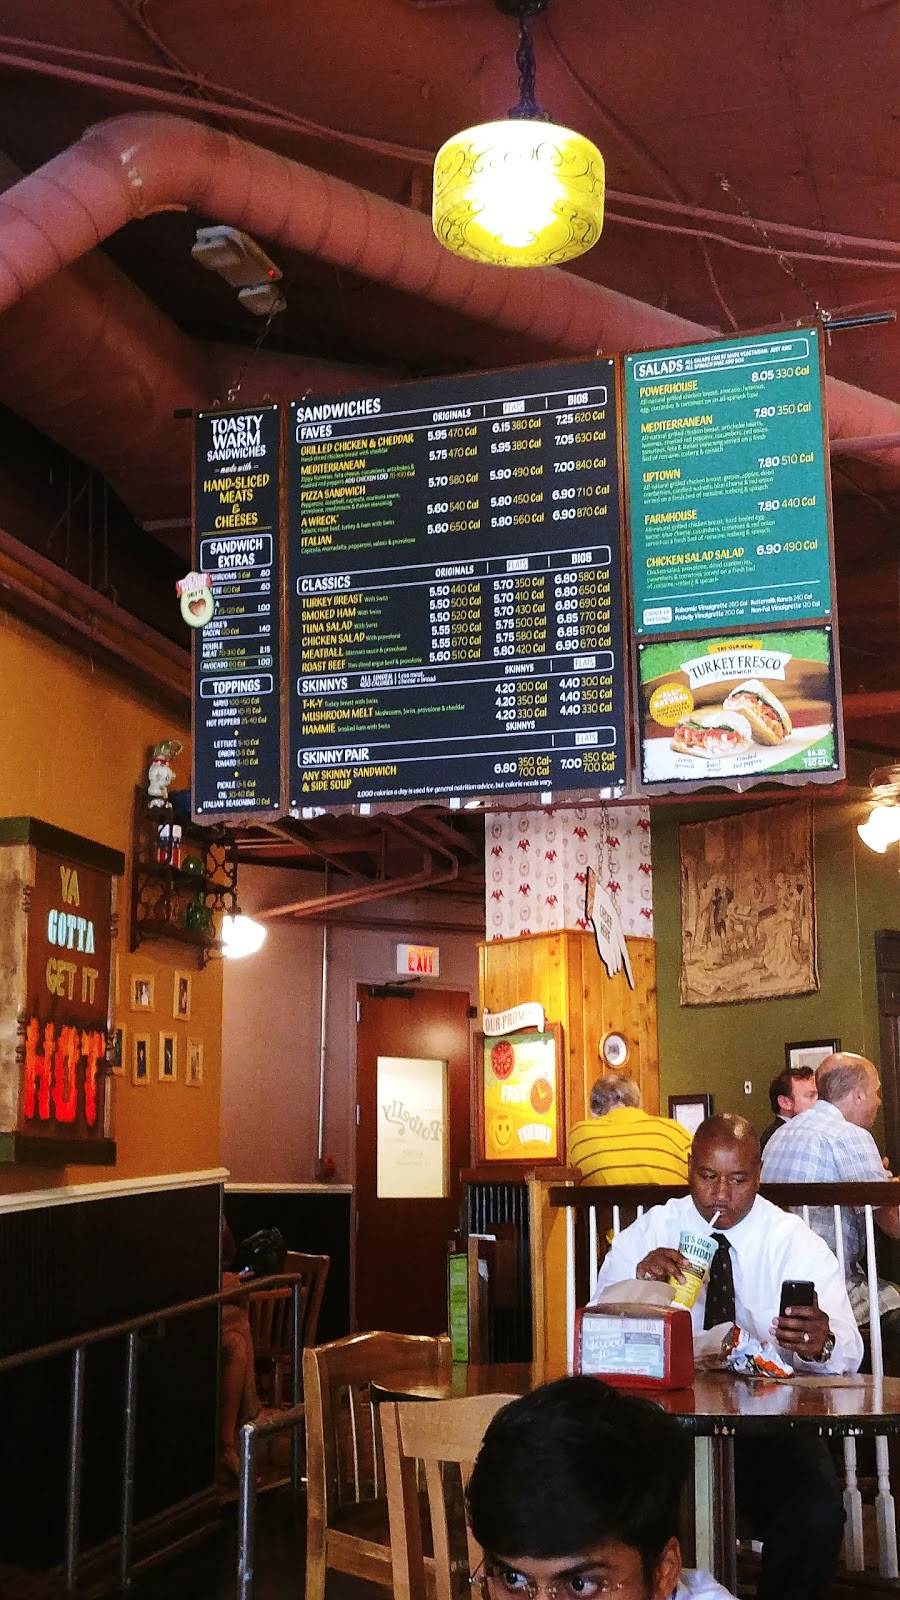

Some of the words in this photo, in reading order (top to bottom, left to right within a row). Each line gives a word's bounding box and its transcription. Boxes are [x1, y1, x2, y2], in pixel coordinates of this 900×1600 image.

[639, 359, 683, 377] SALADS
[752, 370, 774, 382] 8.05
[775, 369, 793, 379] 330
[795, 366, 809, 377] Cal
[640, 380, 698, 397] POWERHOUSE
[568, 393, 589, 405] BIGS
[297, 398, 381, 423] SANDWICHES
[433, 408, 471, 422] ORIGINALS
[556, 414, 573, 425] 7.25
[575, 412, 591, 422] 620
[592, 410, 605, 420] Cal
[754, 407, 775, 418] 7.80
[777, 405, 794, 416] 350
[797, 402, 811, 413] Cal
[211, 414, 263, 434] TOASTY
[301, 424, 332, 439] FAVES
[492, 421, 510, 433] 6.15
[512, 419, 527, 430] 380
[528, 418, 541, 428] Cal
[641, 415, 712, 433] MEDITERRANEAN
[213, 430, 260, 449] WARM
[428, 429, 447, 441] 5.95
[448, 427, 463, 438] 470
[465, 426, 477, 436] Cal
[301, 443, 333, 456] GRILLED
[334, 438, 368, 452] CHICKEN
[369, 440, 376, 448] &
[378, 433, 414, 447] CHEDDAR
[207, 445, 266, 462] SANDWICHES
[758, 458, 779, 468] 7.80
[781, 455, 798, 466] 510
[800, 452, 814, 463] Cal
[301, 459, 365, 475] MEDITERRANEAN
[554, 461, 575, 473] 7.00
[576, 460, 592, 470] 840
[593, 458, 606, 468] Cal
[203, 474, 269, 492] HAND-SLICED
[643, 469, 680, 483] UPTOWN
[220, 489, 253, 504] MEATS
[301, 490, 323, 502] PIZZA
[324, 485, 366, 499] SANDWICH
[232, 504, 240, 513] &
[758, 501, 779, 512] 7.80
[781, 499, 800, 509] 440
[802, 496, 816, 507] Cal
[215, 512, 258, 528] CHEESES
[553, 508, 576, 521] 6.90
[577, 507, 593, 518] 870
[594, 505, 607, 516] Cal
[645, 510, 697, 524] FARMHOUSE
[301, 518, 307, 527] A
[210, 538, 263, 555] SANDWICH
[301, 535, 332, 547] ITALIAN
[757, 544, 782, 556] 6.90
[783, 542, 801, 552] 490
[804, 540, 817, 551] Cal
[218, 553, 255, 568] EXTRAS
[571, 552, 592, 564] BIGS
[647, 554, 683, 568] CHICKEN
[684, 551, 713, 563] SALAD
[715, 548, 744, 559] SALAD
[435, 565, 474, 577] ORIGINALS
[554, 573, 577, 584] 6.80
[578, 571, 595, 582] 580
[597, 570, 609, 580] Cal
[302, 575, 351, 591] CLASSICS
[494, 579, 513, 590] 5.70
[514, 578, 530, 588] 350
[532, 576, 544, 587] Cal
[302, 595, 331, 608] TURKEY
[333, 593, 363, 606] BREAST
[302, 609, 335, 621] SMOKED
[337, 608, 356, 617] HAM
[557, 612, 578, 624] 6.85
[580, 611, 595, 622] 770
[597, 610, 610, 620] Cal
[302, 623, 324, 633] TUNA
[326, 620, 352, 631] SALAD
[302, 635, 337, 646] CHICKEN
[338, 632, 365, 644] SALAD
[302, 647, 344, 659] MEATBALL
[302, 662, 326, 672] ROAST
[328, 659, 346, 670] BEEF
[505, 663, 534, 674] SKINNYS
[690, 656, 736, 679] TURKEY
[738, 656, 781, 670] FRESCO
[213, 679, 260, 694] TOPPINGS
[302, 677, 347, 692] SKINNYS
[495, 683, 515, 694] 4.20
[516, 683, 533, 692] 300
[535, 681, 548, 691] Cal
[559, 677, 579, 689] 4.40
[581, 677, 597, 686] 300
[600, 675, 613, 685] Cal
[560, 691, 579, 702] 4.40
[582, 690, 597, 700] 350
[600, 689, 612, 699] Cal
[302, 710, 351, 722] MUSHROOM
[352, 708, 372, 719] MELT
[302, 723, 336, 735] HAMMIE
[506, 720, 535, 731] SKINNYS
[303, 749, 344, 764] SKINNY
[345, 747, 369, 760] PAIR
[494, 762, 517, 774] 6.80
[560, 758, 582, 770] 7.00
[302, 770, 320, 780] ANY
[321, 768, 351, 780] SKINNY
[353, 765, 397, 778] SANDWICH
[311, 781, 328, 791] SIDE
[330, 779, 352, 790] SOUP
[60, 865, 80, 907] YA
[47, 909, 95, 954] GOTTA
[408, 947, 433, 973] EXIT
[46, 957, 77, 1001] GET
[82, 966, 99, 1004] IT
[24, 1016, 105, 1128] HOT
